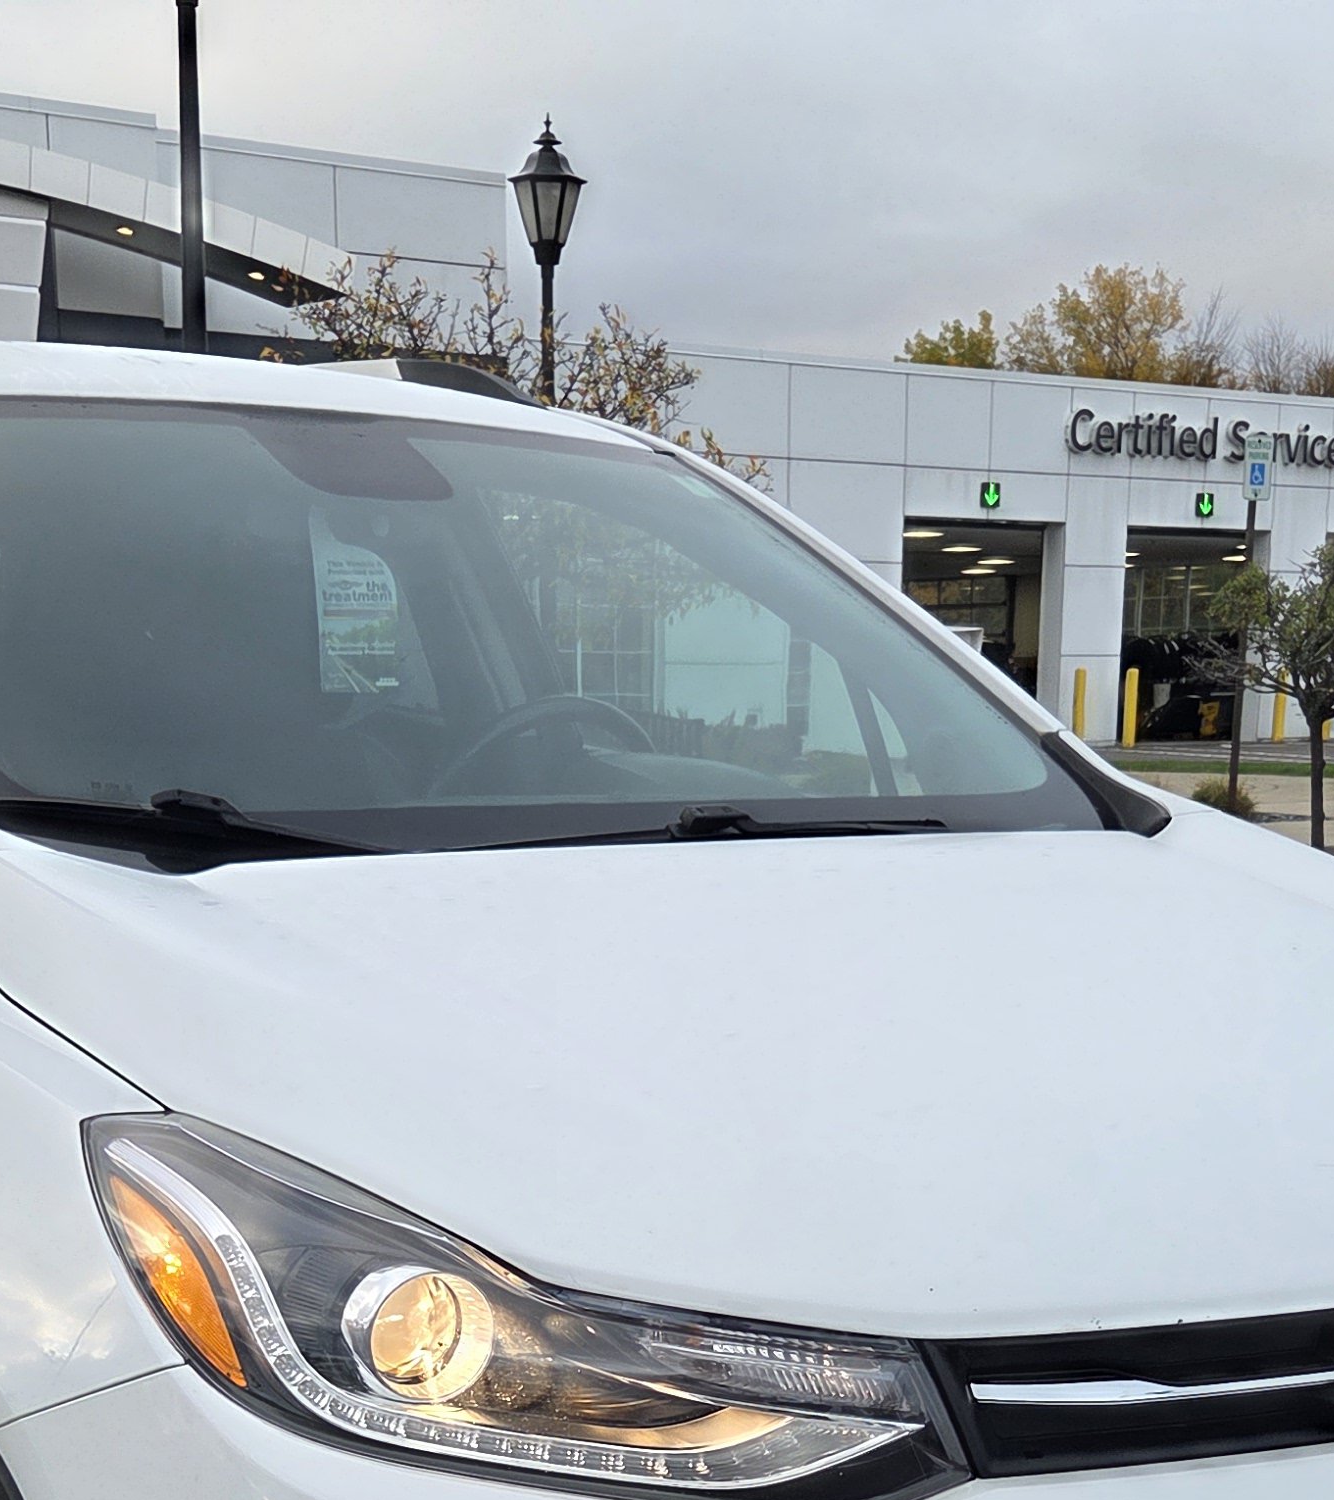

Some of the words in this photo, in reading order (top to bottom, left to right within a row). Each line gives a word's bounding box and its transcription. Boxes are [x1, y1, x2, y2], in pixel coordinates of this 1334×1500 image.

[1067, 408, 1220, 461] Certified
[366, 580, 389, 592] the
[322, 589, 393, 602] treatment
